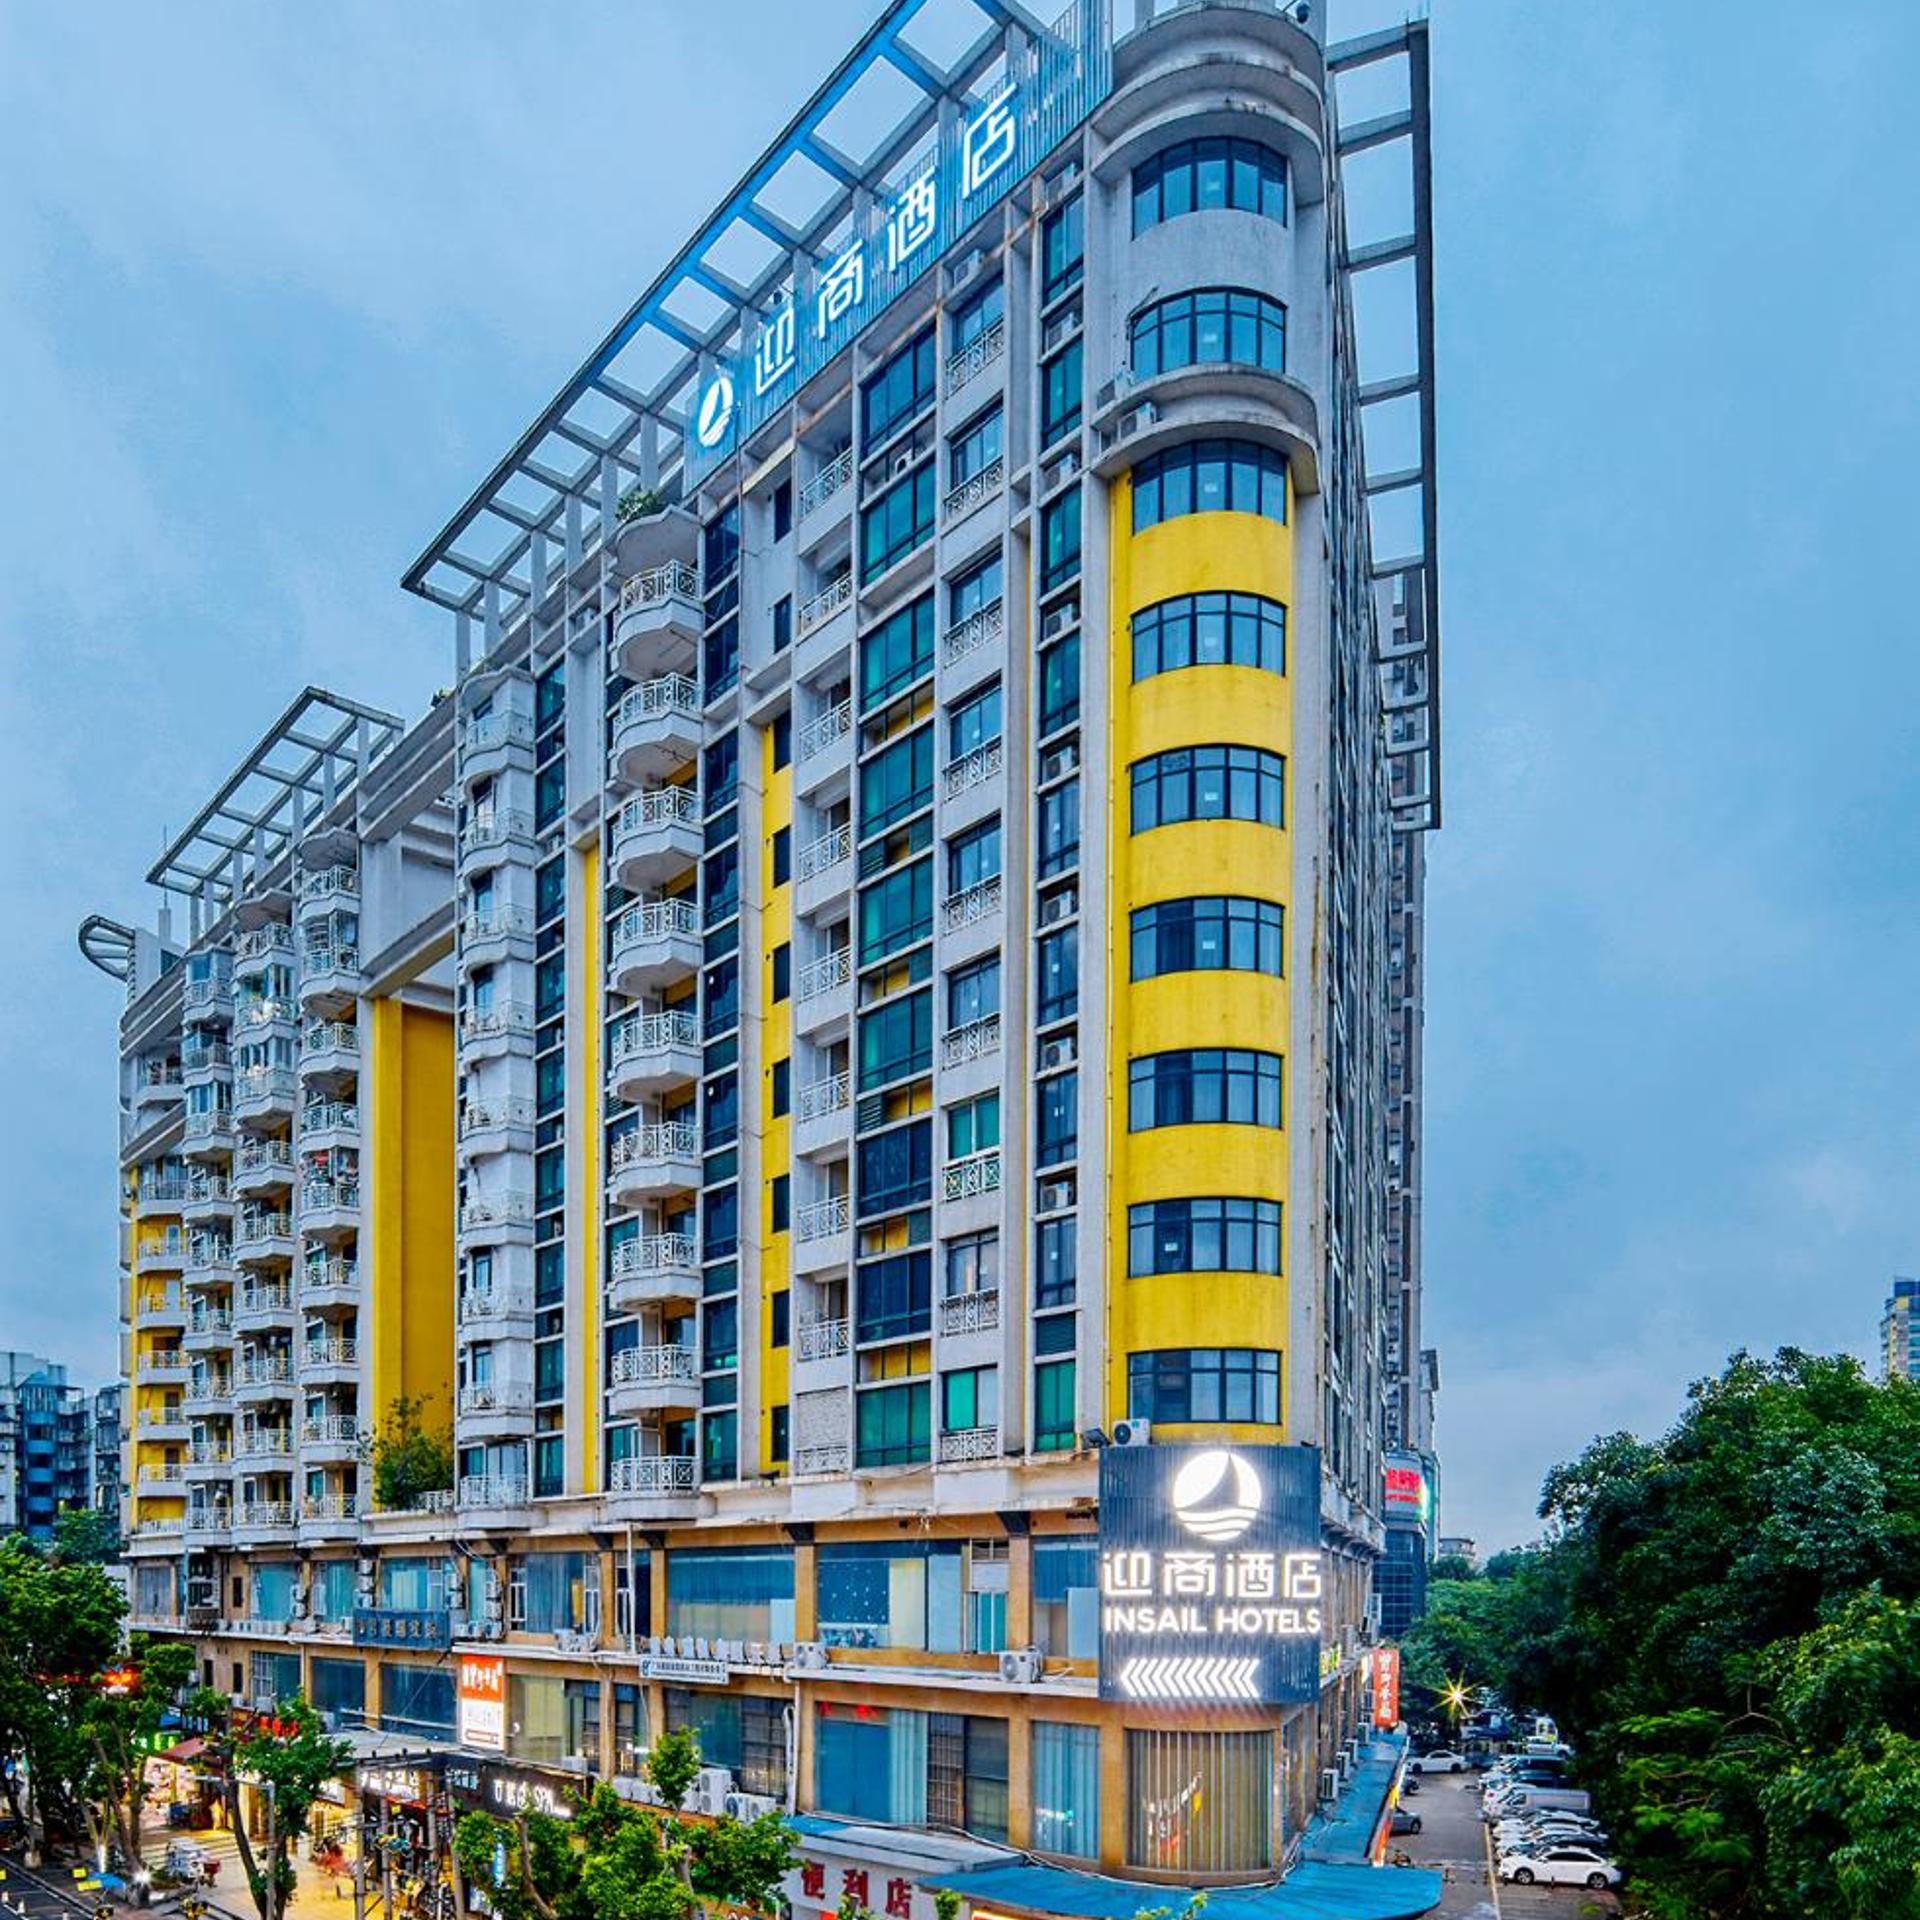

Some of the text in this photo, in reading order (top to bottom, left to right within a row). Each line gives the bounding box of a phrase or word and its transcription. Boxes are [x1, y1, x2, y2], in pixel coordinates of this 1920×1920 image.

[755, 82, 1018, 396] 迎商酒店
[1102, 1552, 1322, 1599] 迎商酒店
[1104, 1607, 1322, 1635] INSAIL HOTELS
[801, 1861, 911, 1920] 便利店
